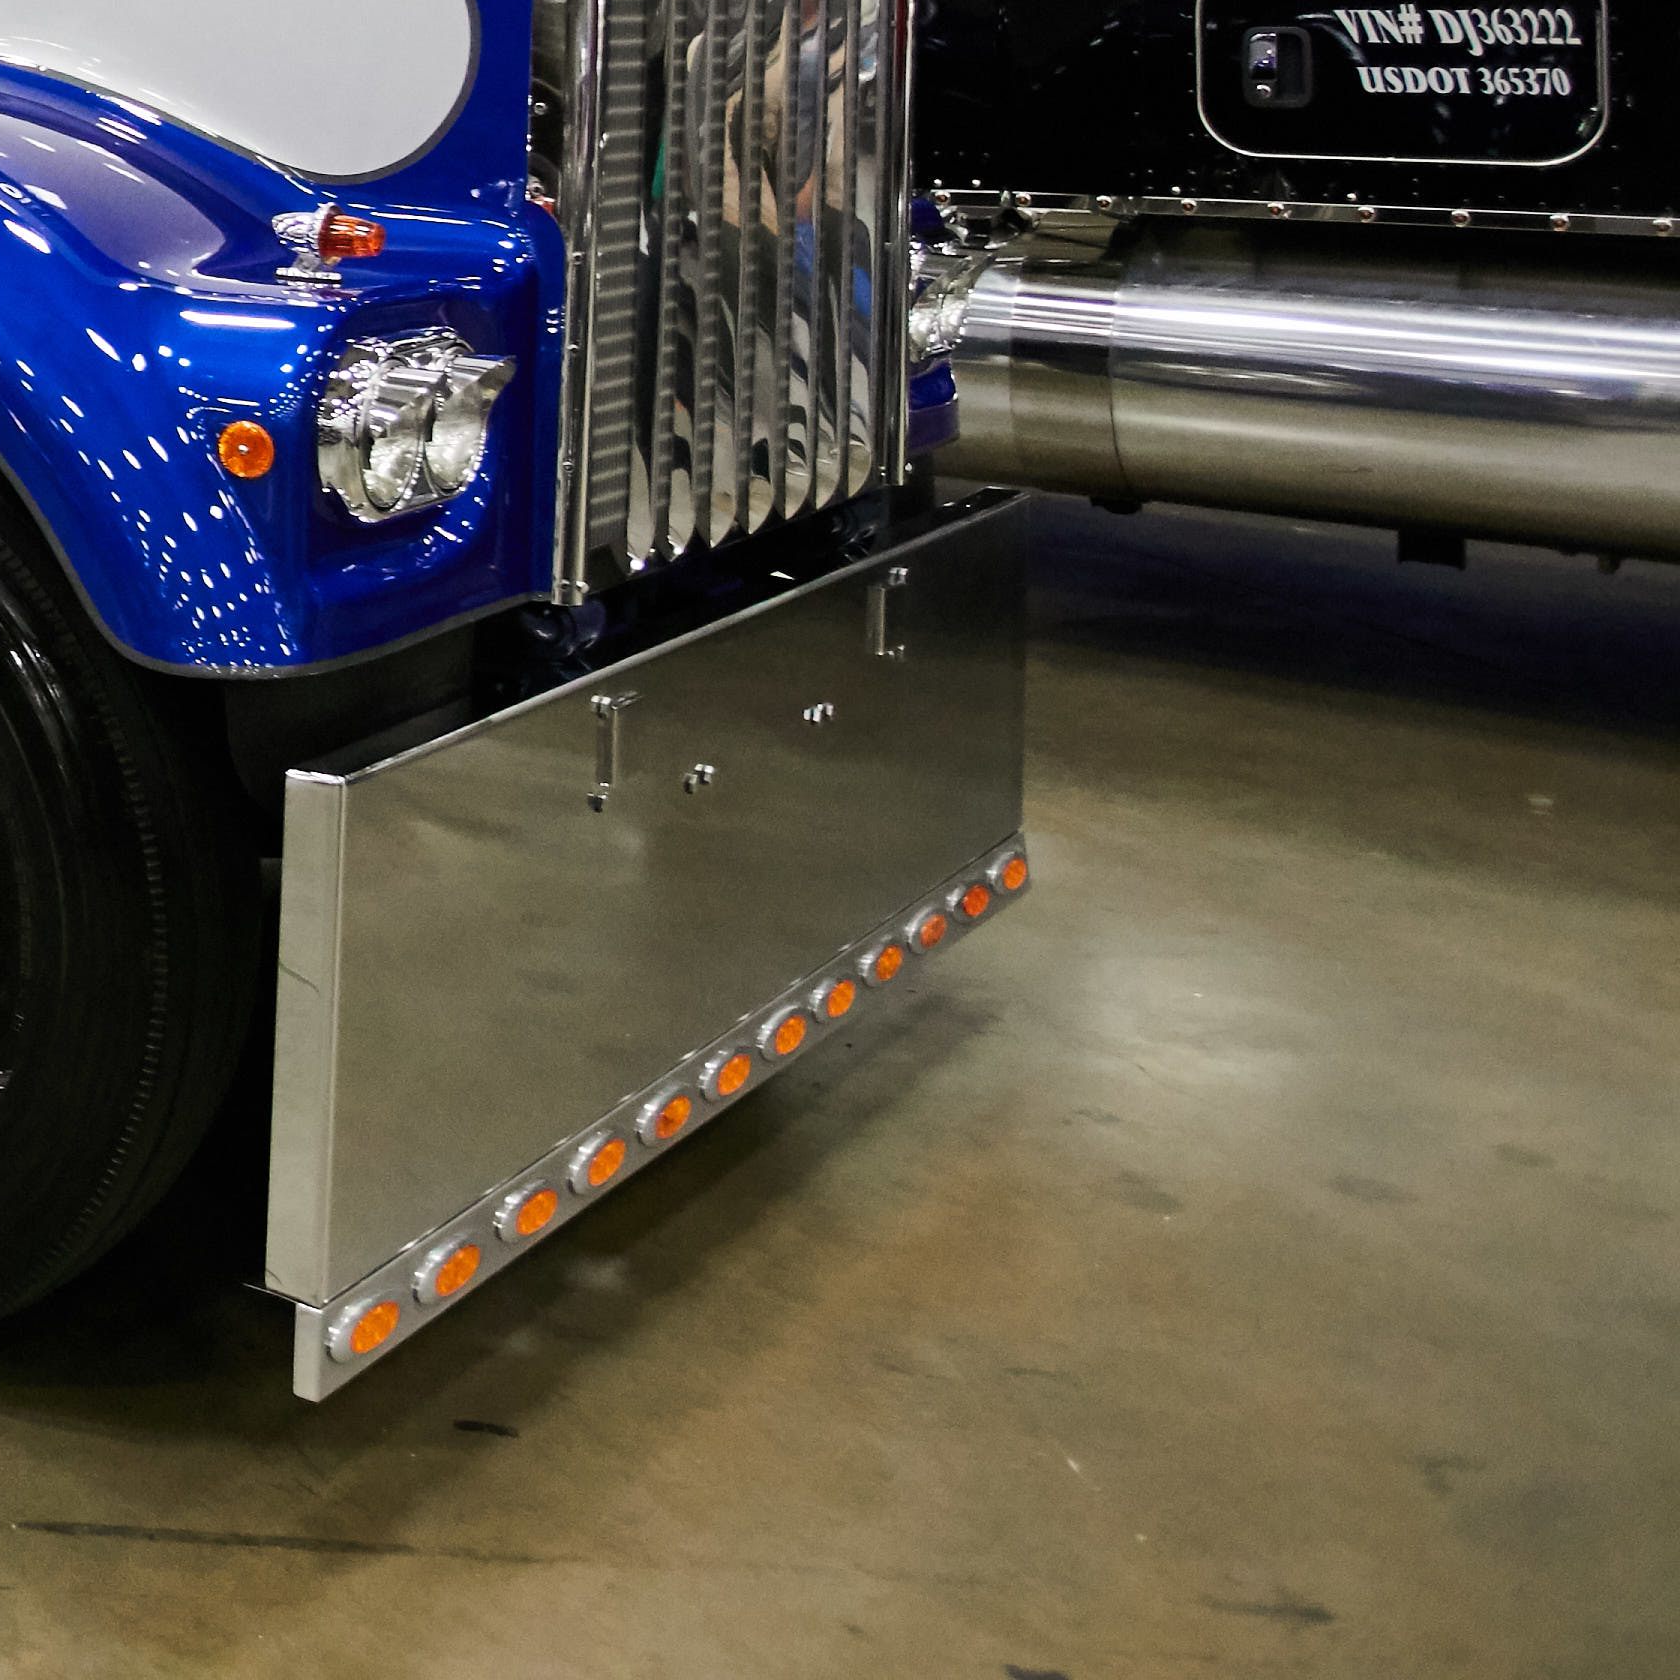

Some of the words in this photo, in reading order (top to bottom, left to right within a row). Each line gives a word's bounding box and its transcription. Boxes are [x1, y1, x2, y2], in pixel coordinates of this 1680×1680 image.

[1333, 3, 1424, 45] VIN#
[1426, 8, 1583, 57] DJ363222
[1356, 66, 1471, 94] USDOT
[1476, 67, 1571, 96] 365370
